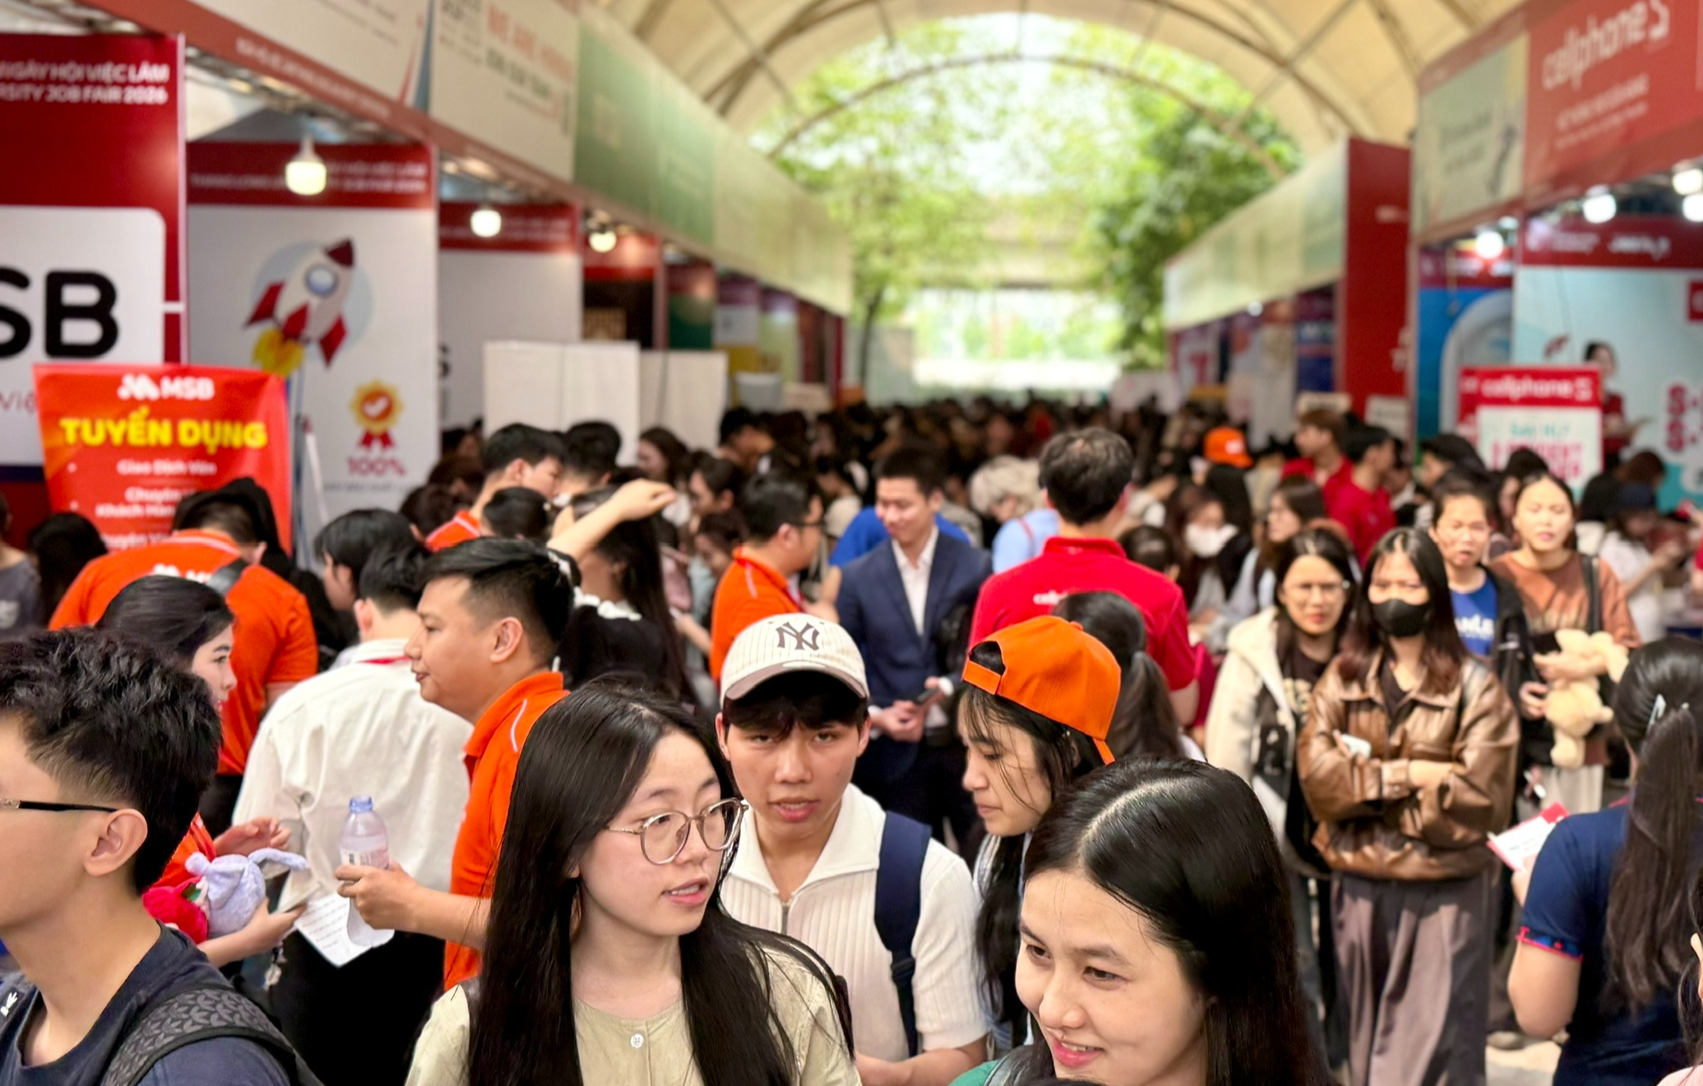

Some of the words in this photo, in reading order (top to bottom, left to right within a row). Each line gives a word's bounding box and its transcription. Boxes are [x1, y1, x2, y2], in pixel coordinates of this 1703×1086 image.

[160, 376, 215, 400] MSB
[59, 406, 172, 447] TUYỂN
[178, 418, 268, 455] DỤNG
[776, 621, 820, 651] NY
